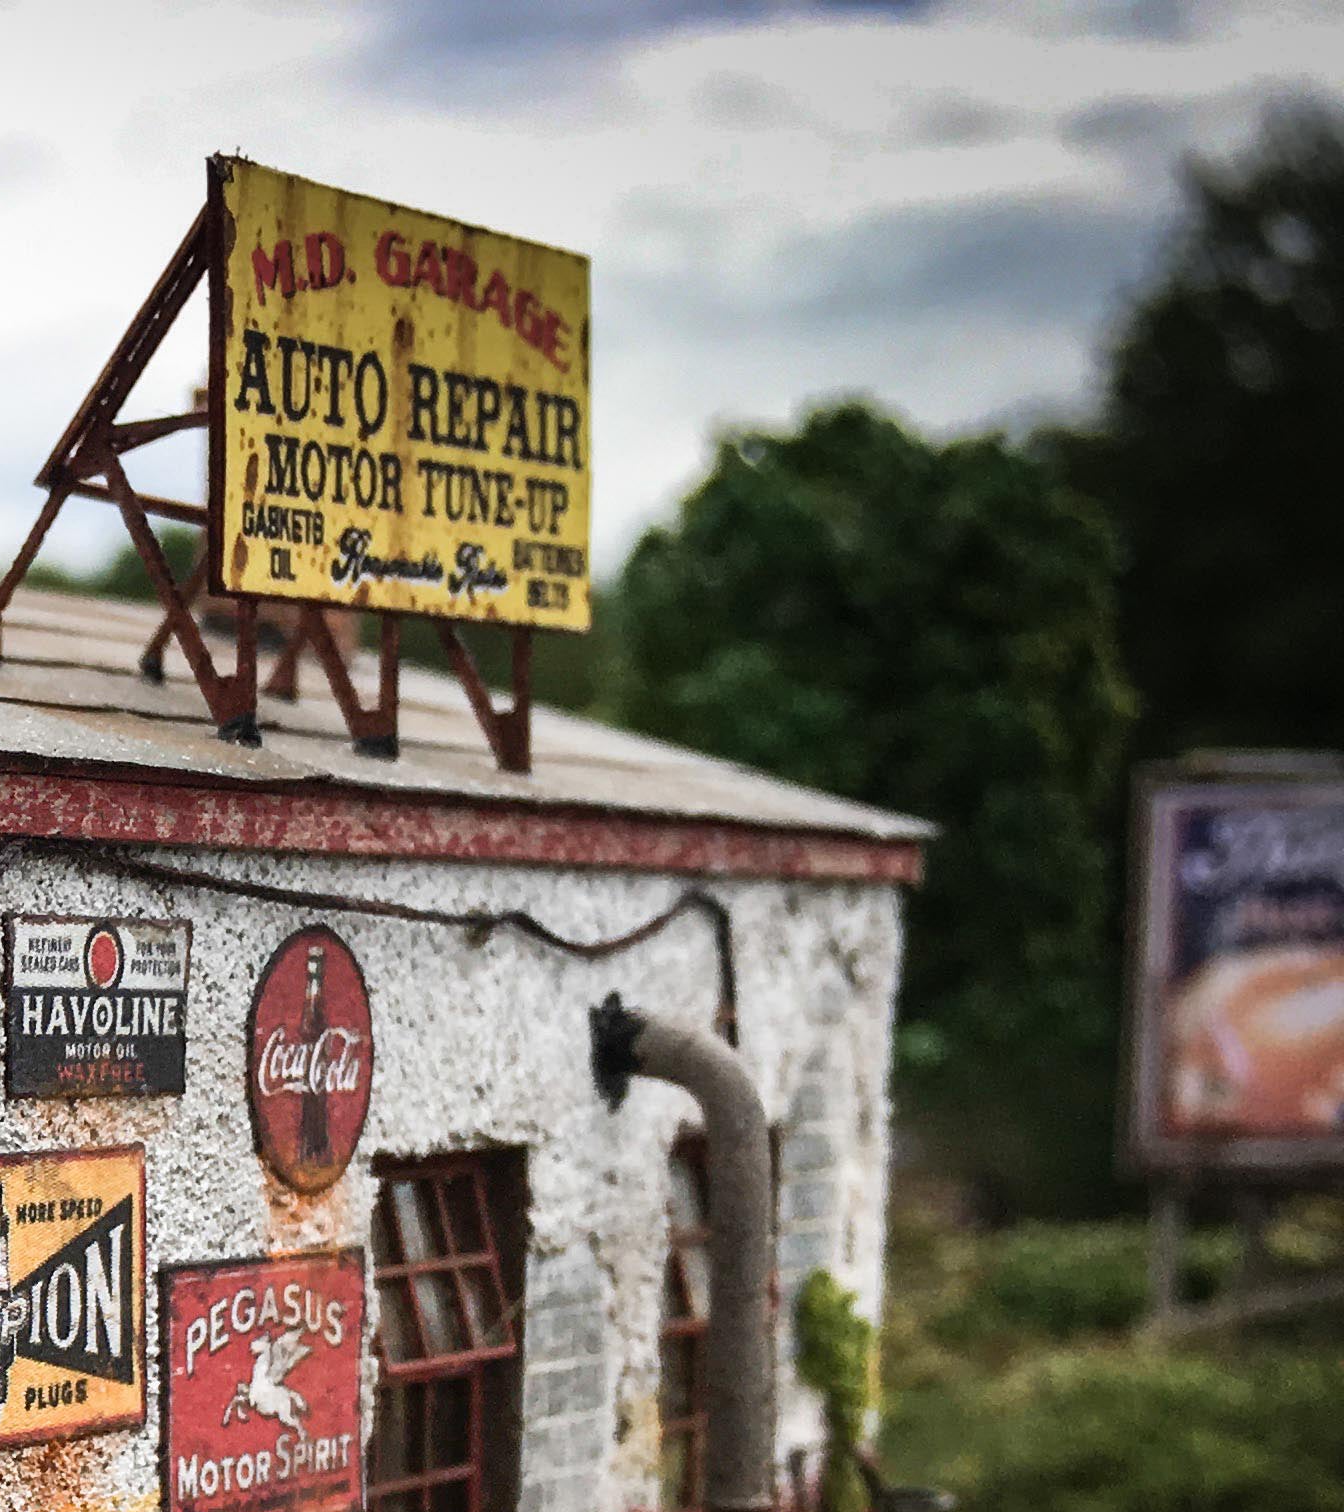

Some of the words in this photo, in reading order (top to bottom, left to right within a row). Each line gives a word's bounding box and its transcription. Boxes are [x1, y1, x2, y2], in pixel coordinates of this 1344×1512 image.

[251, 231, 357, 307] M.D.
[374, 229, 573, 375] GARAGE
[233, 328, 389, 440] AUTO
[407, 363, 584, 471] REPAIR
[264, 434, 404, 513] MOTOR
[416, 458, 570, 536] TUNE-UP
[241, 500, 325, 546] GASKETS
[269, 547, 297, 582] OIL
[21, 994, 179, 1037] HAVOLINE
[65, 1043, 112, 1060] MOTOR
[115, 1043, 138, 1061] OIL
[14, 1200, 56, 1225] MORE
[59, 1196, 104, 1221] SPEED
[185, 1282, 348, 1379] PEGASUS
[23, 1377, 90, 1412] PLUGS
[176, 1450, 272, 1501] MOTOR
